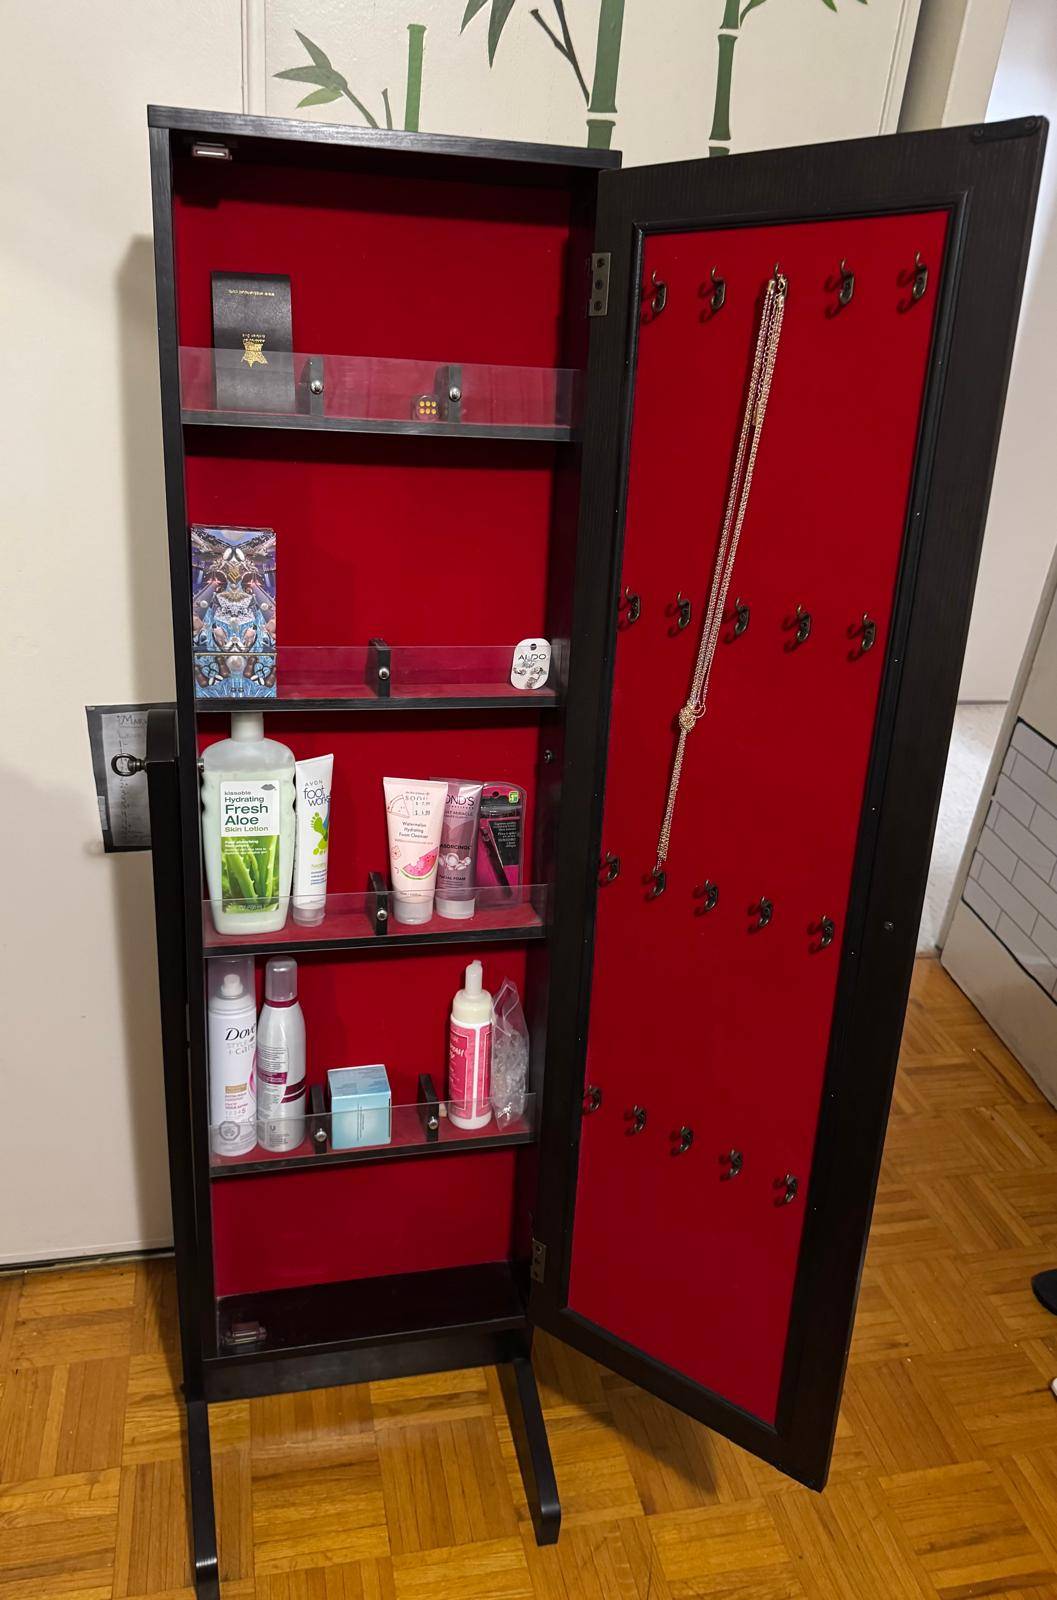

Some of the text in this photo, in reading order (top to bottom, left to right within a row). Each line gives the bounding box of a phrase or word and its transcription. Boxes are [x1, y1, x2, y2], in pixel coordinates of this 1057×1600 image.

[518, 653, 547, 661] ALDO
[304, 779, 323, 787] AVON
[303, 785, 325, 800] foot
[224, 796, 265, 804] Hydrating
[445, 793, 475, 807] OND'S
[225, 803, 269, 815] Fresh
[224, 815, 260, 826] Aloe
[224, 1023, 257, 1041] Dove
